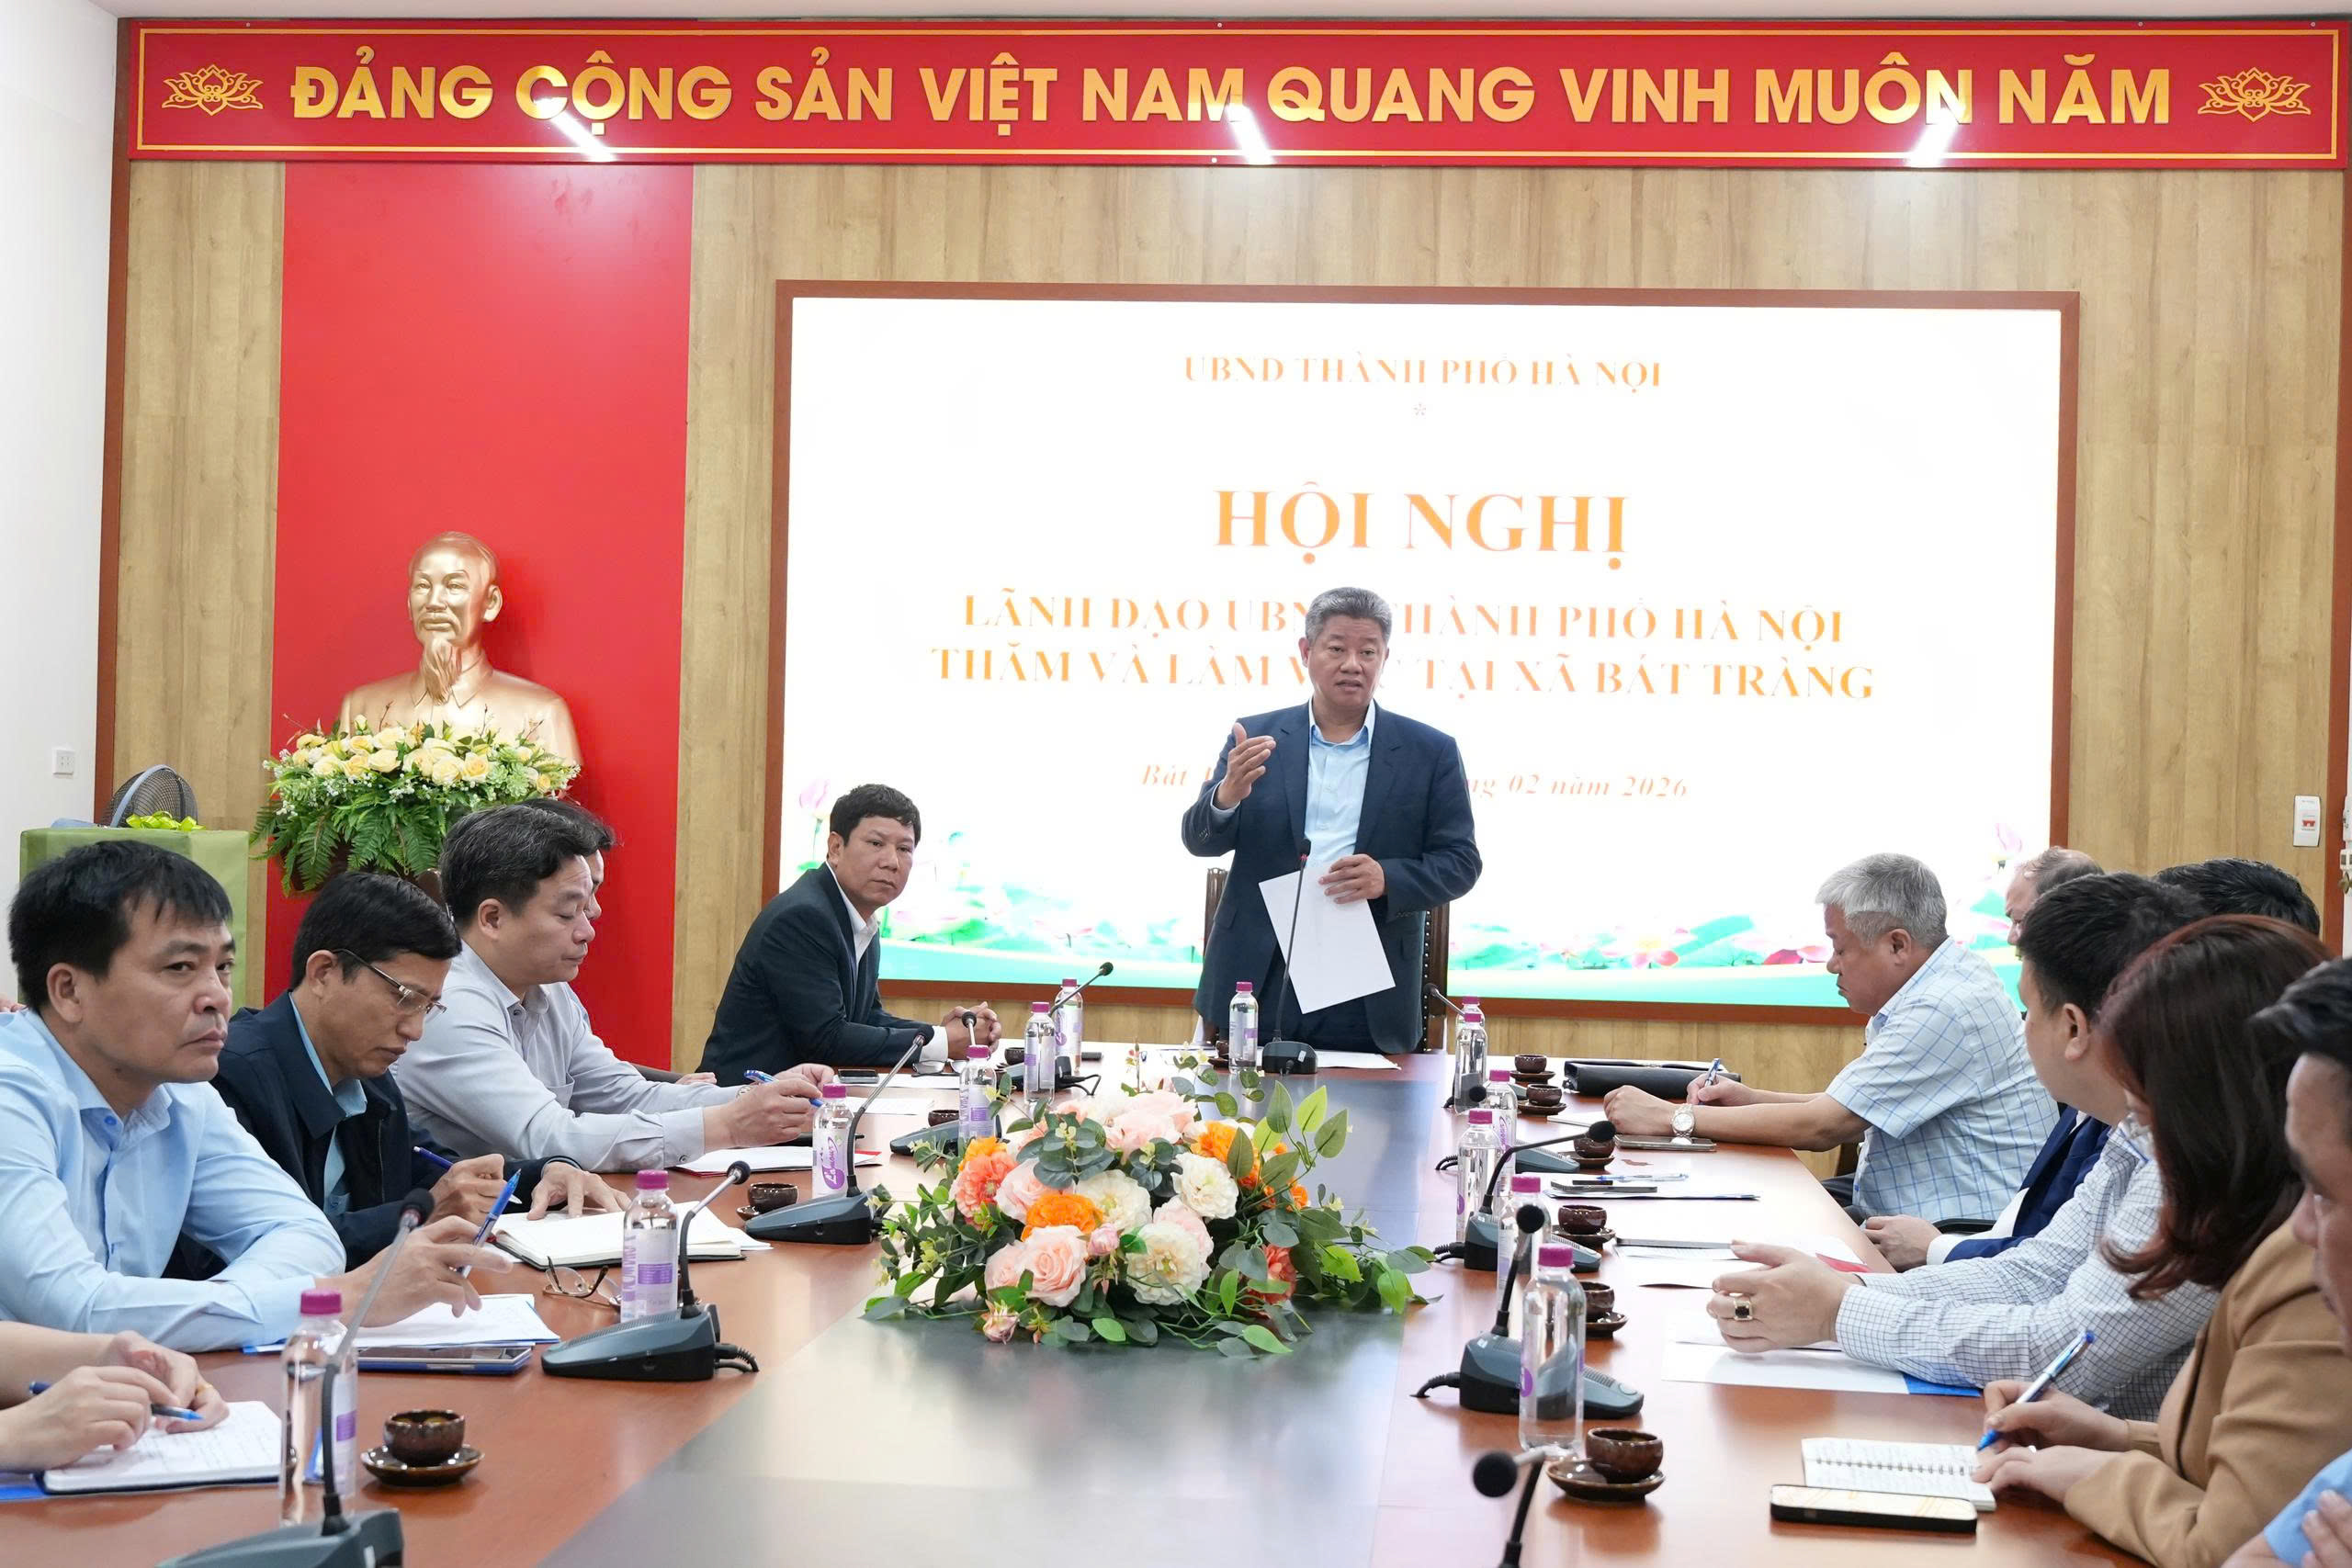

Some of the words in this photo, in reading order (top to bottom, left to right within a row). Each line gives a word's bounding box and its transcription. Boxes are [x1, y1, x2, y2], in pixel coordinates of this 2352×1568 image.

[290, 46, 493, 119] ĐẢNG
[515, 50, 732, 136] CỘNG
[755, 46, 893, 121] SẢN
[920, 52, 1058, 136] VIỆT
[1083, 68, 1246, 123] NAM
[1267, 67, 1535, 122] QUANG
[1560, 69, 1729, 123] VINH
[1756, 52, 1973, 125] MUÔN
[1999, 53, 2169, 124] NĂM
[1185, 355, 1284, 383] UBND
[1298, 351, 1427, 384] THÀNH
[1531, 354, 1581, 386] HÀ
[1214, 480, 1374, 566] HỘI
[1403, 491, 1631, 571] NGHỊ
[964, 588, 1092, 628] LÃNH
[1675, 601, 1740, 642] HÀ
[1758, 605, 1843, 652] NỘI
[932, 642, 1071, 683] THĂM
[1088, 644, 1149, 685] VÀ
[1168, 646, 1270, 686] LÀM
[1416, 658, 1495, 699] TẠI
[1515, 653, 1577, 693] XÃ
[1597, 653, 1691, 695] BÁT
[1703, 656, 1874, 699] TRÀNG
[1509, 774, 1540, 795] 02
[1623, 776, 1687, 797] 2026
